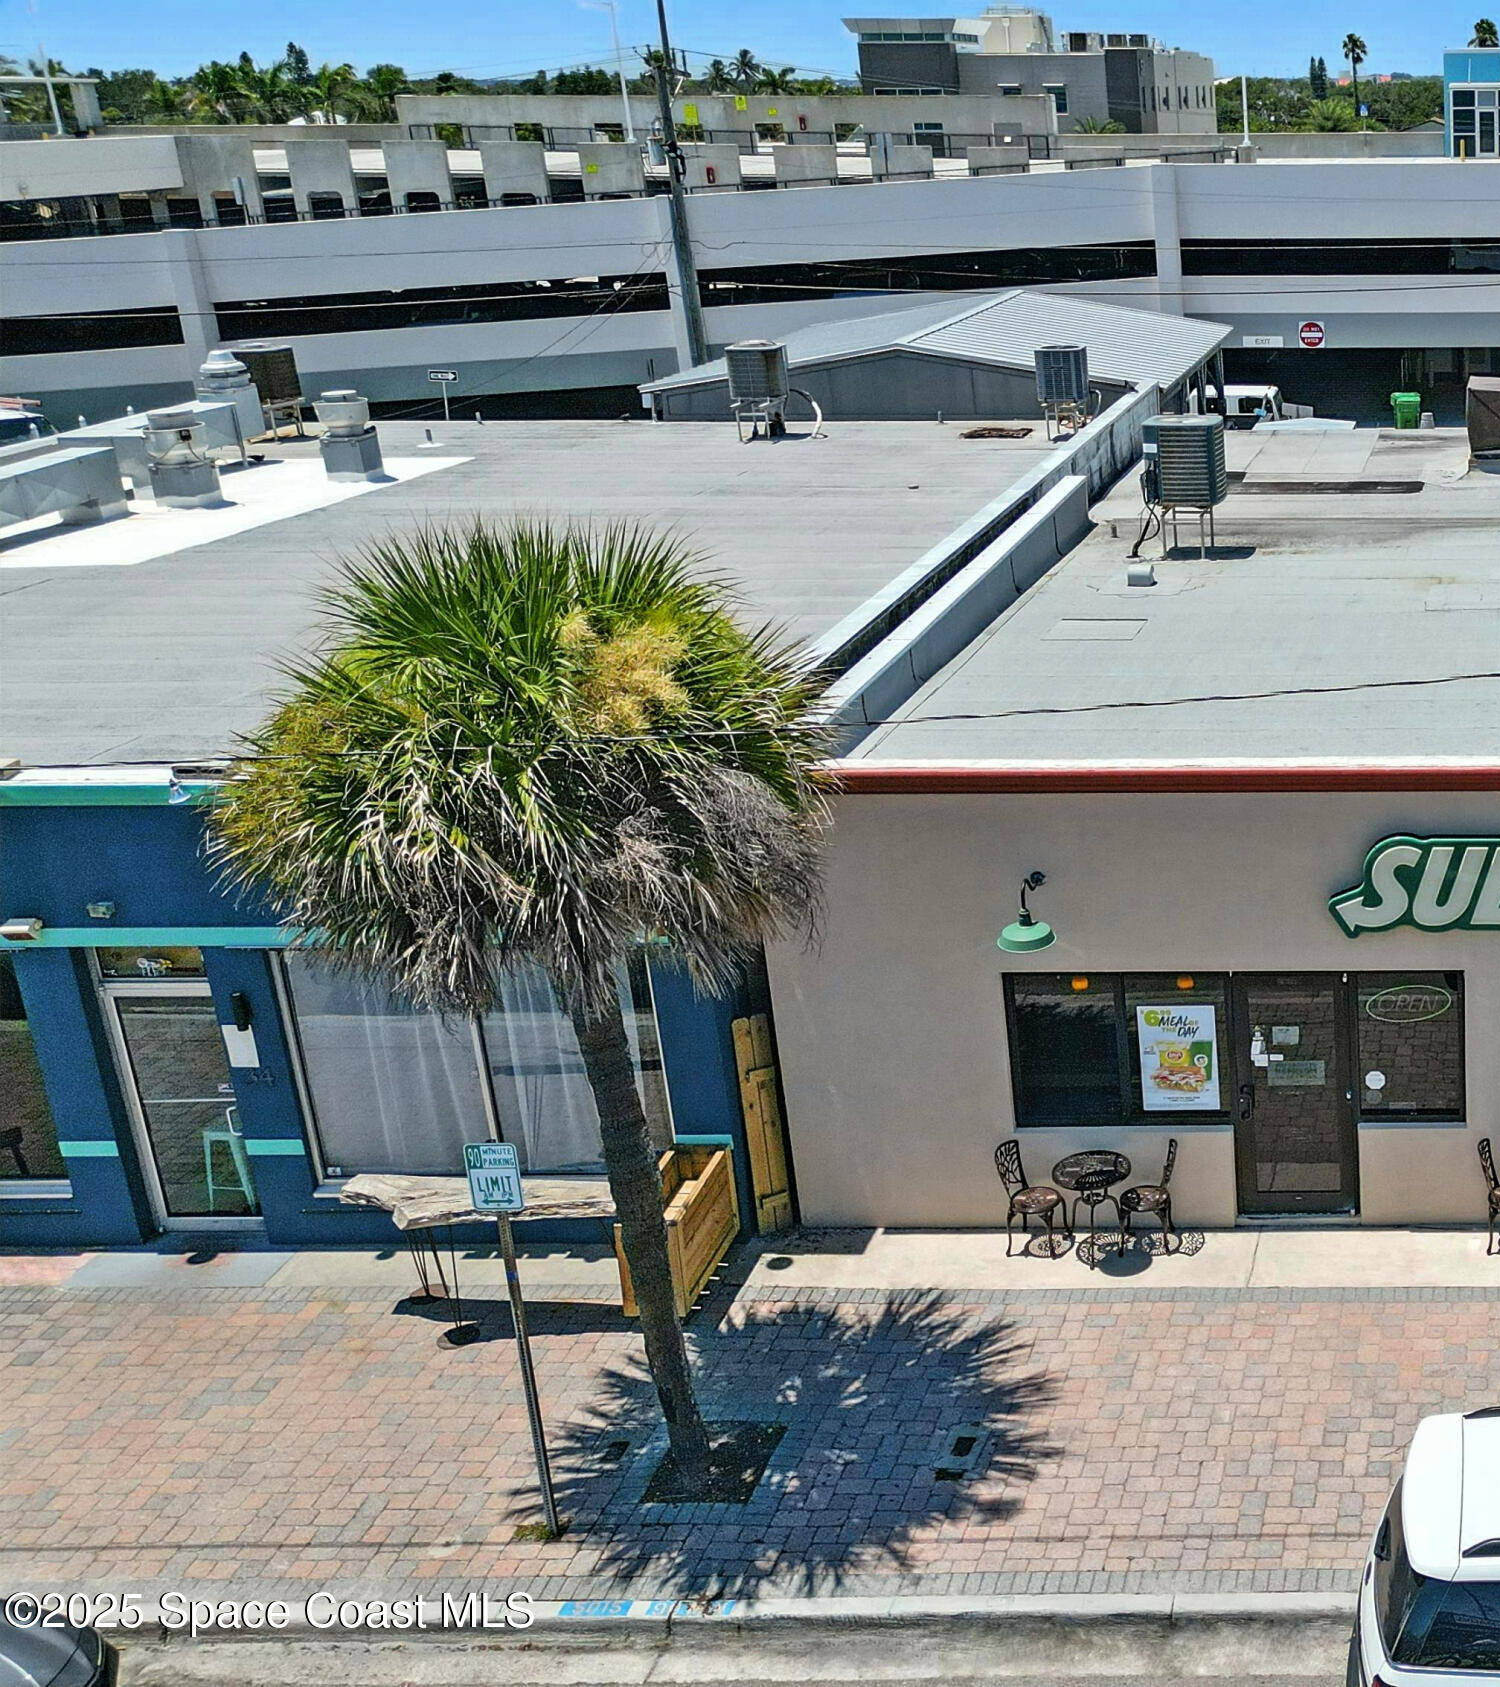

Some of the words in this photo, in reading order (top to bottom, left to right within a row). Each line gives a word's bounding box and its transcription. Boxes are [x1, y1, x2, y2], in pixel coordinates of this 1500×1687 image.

[1378, 995, 1438, 1012] OPEN
[1158, 1016, 1188, 1027] MEAL
[1177, 1026, 1200, 1038] DAY
[467, 1148, 481, 1167] 90
[482, 1147, 513, 1156] MINUTE
[483, 1158, 515, 1166] PARKING
[477, 1176, 512, 1193] LIMIT
